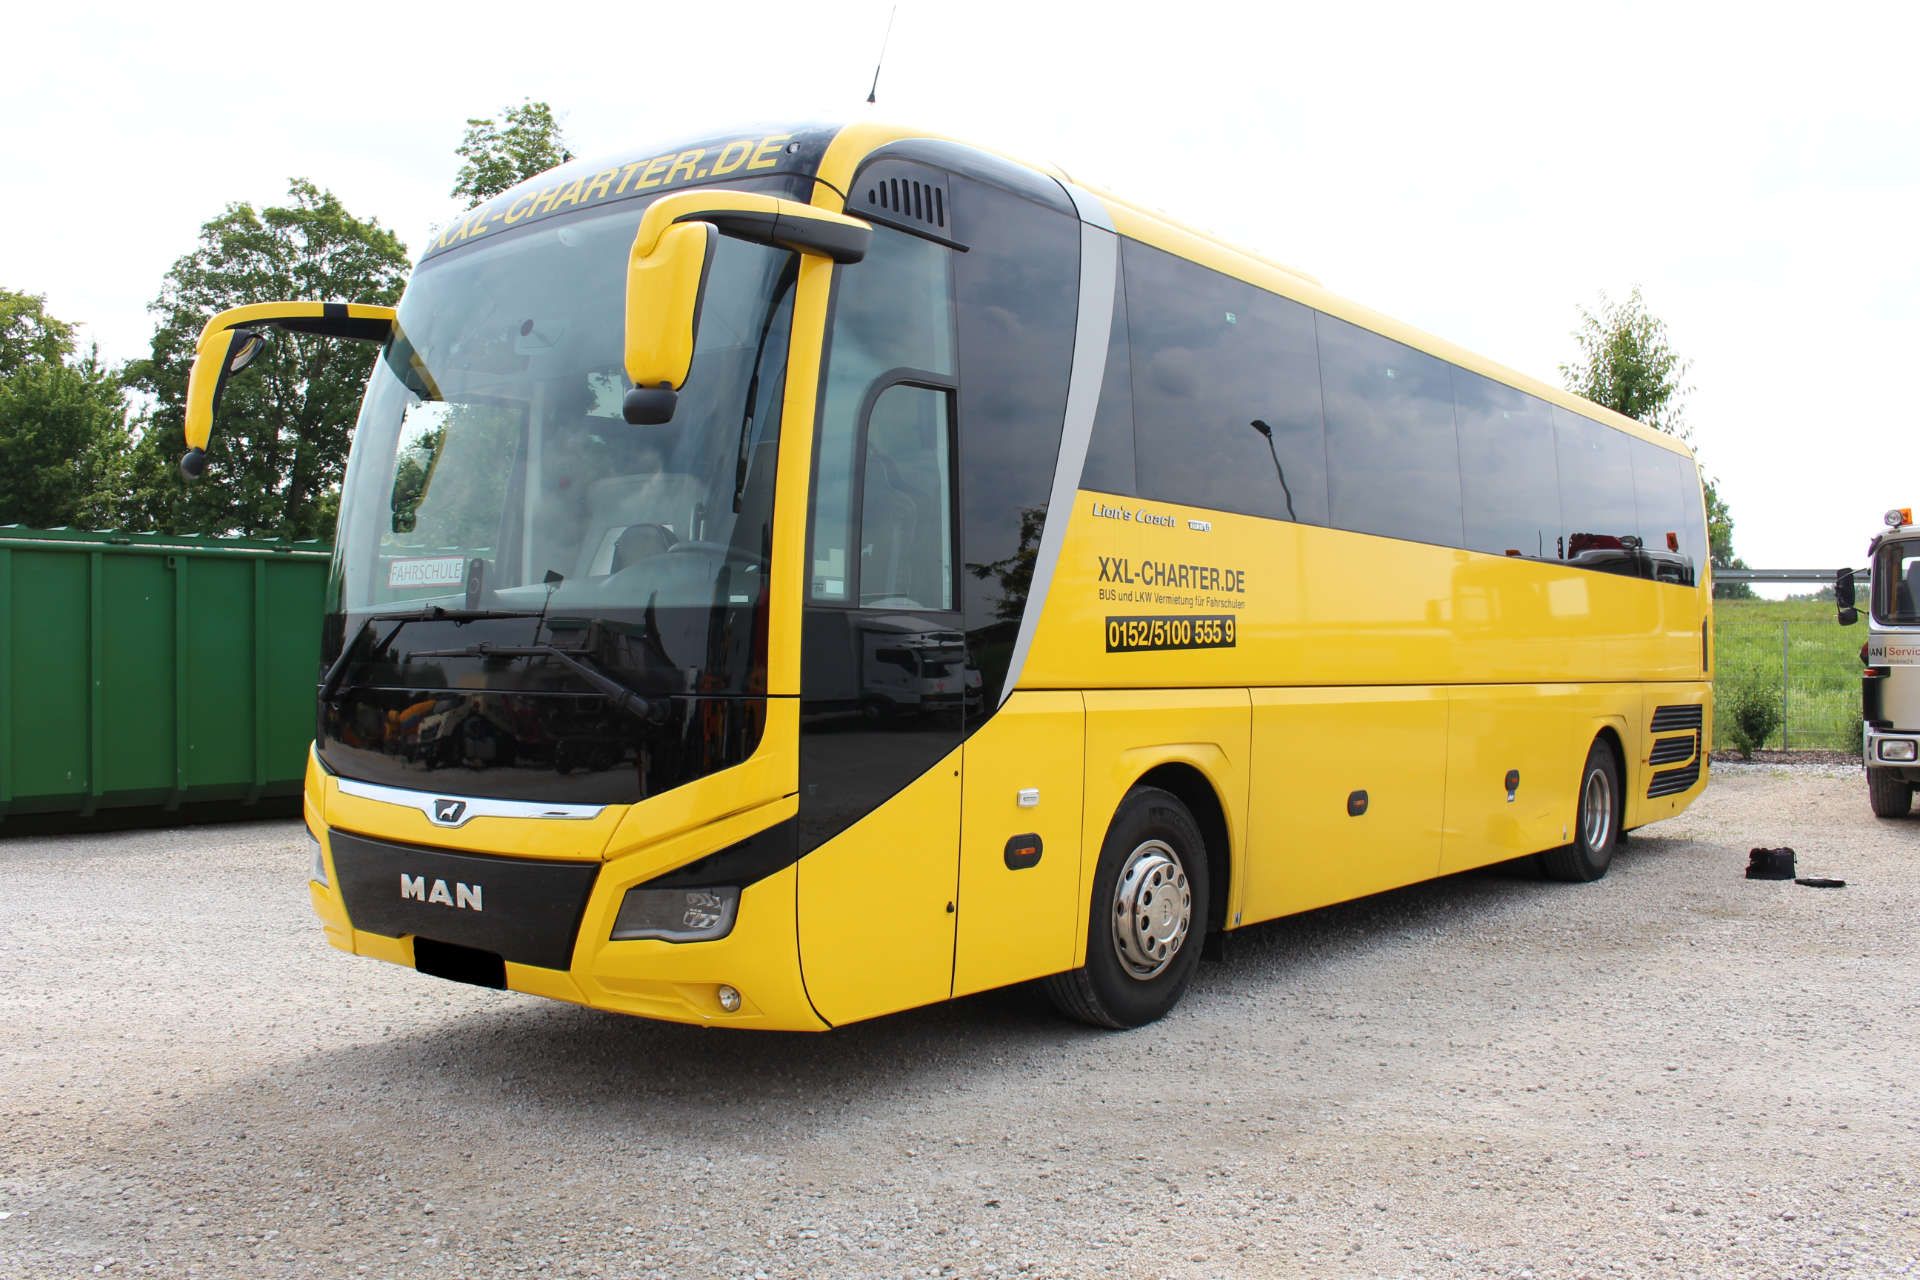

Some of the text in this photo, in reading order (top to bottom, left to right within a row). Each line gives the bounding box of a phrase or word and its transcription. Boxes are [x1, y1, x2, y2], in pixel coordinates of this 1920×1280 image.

[428, 134, 792, 254] XXL-CHARTER.DE
[1092, 503, 1131, 520] Lion's
[1136, 509, 1176, 527] Coach
[391, 562, 463, 580] FAHRSCHULE
[1098, 556, 1245, 593] XXL-CHARTER.DE
[1099, 588, 1246, 609] BUS und LKW Vermietung für Fahrschulen
[1109, 619, 1235, 647] 0152/5100 555 9
[401, 873, 483, 912] MAN
